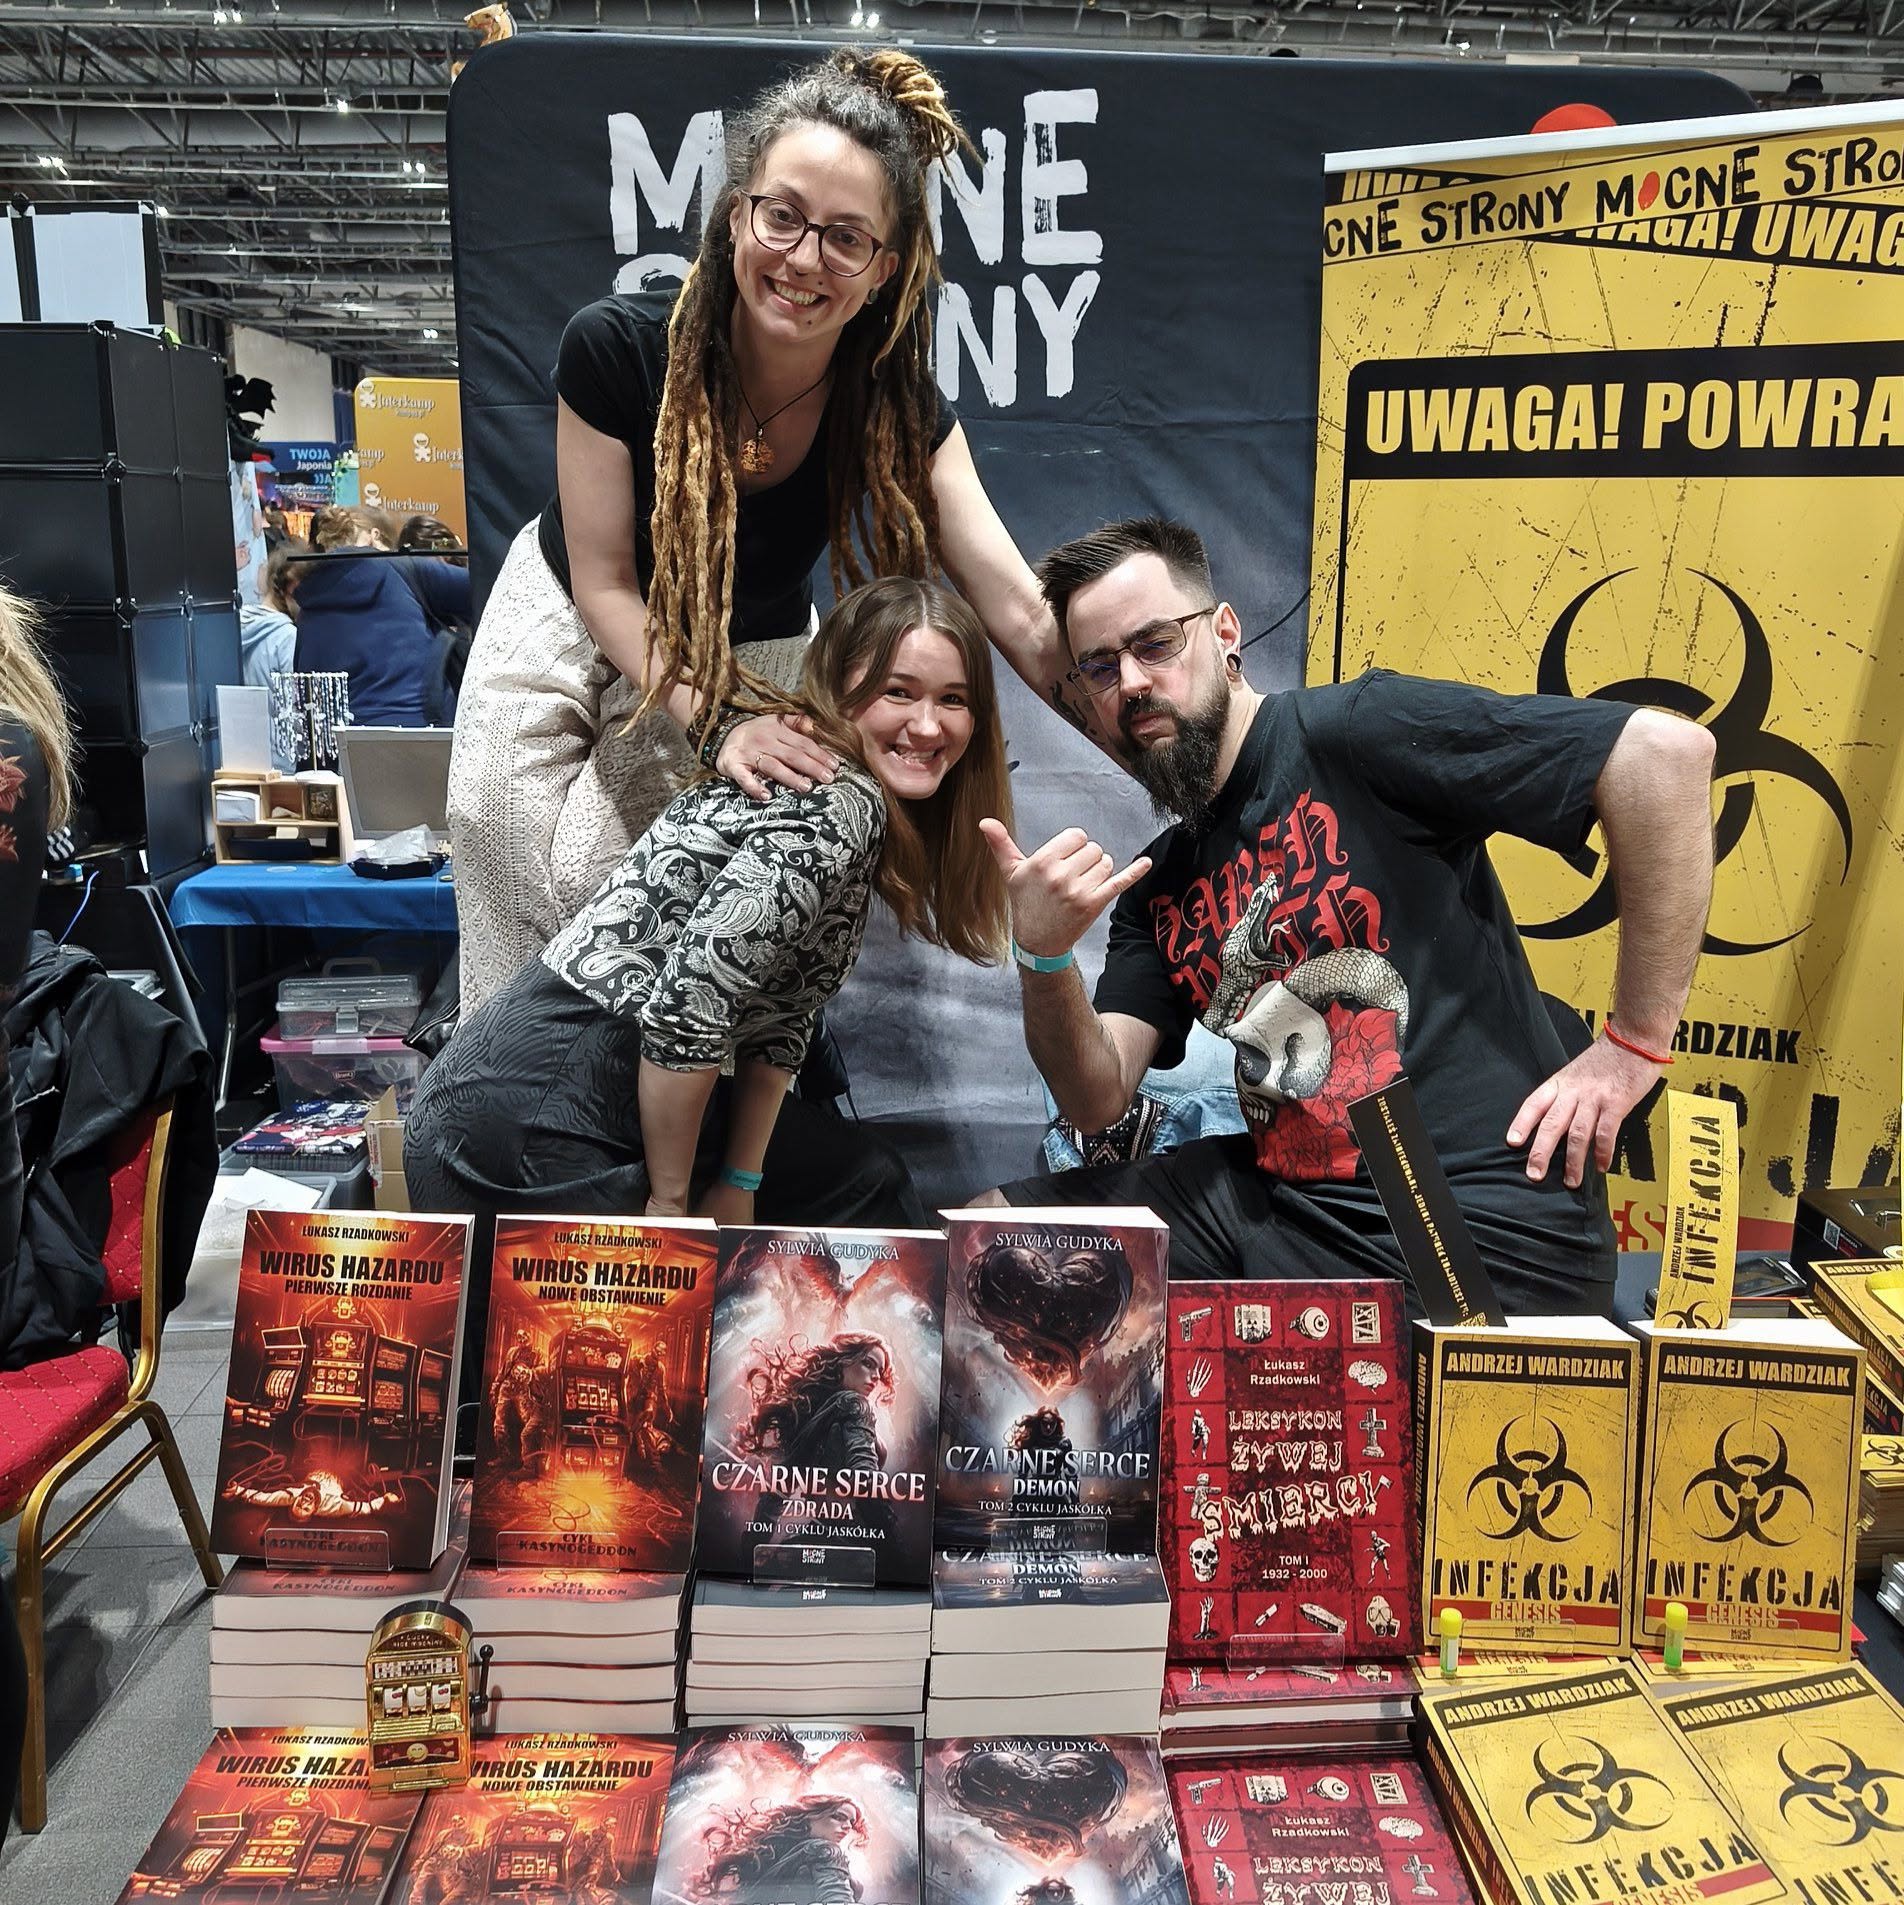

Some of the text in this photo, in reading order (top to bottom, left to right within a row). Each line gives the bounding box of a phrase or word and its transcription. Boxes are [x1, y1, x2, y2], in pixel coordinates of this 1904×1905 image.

[608, 88, 1103, 265] MNE
[1366, 376, 1904, 454] UWAGA! POWRA
[289, 448, 331, 460] TWOJA
[296, 460, 333, 472] Japonia
[1671, 1019, 1801, 1064] RDZIAK
[1682, 1115, 1722, 1285] INFEKCJA
[302, 1225, 410, 1243] ŁUKASZ RZADKOWSKI
[554, 1232, 663, 1250] ŁUKASZ RZADKOWSKI
[995, 1232, 1124, 1252] SYLWIA GUDYKA
[1669, 1205, 1686, 1279] ANDRZEJ WARDZIAK
[766, 1239, 900, 1261] SYLWIA GUDYKA
[259, 1250, 445, 1285] WIRUS HAZARDU
[512, 1257, 698, 1291] WIRUS HAZARDU
[285, 1279, 413, 1301] PIERWSZE ROZDANIE
[538, 1285, 666, 1306] NOWE OBSTAWIENIE
[1264, 1359, 1305, 1371] Łukasz
[1446, 1352, 1625, 1380] ANDRZEJ WARDZIAK
[1663, 1354, 1744, 1379] ANDRZEJ
[1749, 1359, 1851, 1388] WARDZIAK
[1250, 1374, 1321, 1386] Rzadkowski
[1416, 1352, 1427, 1420] ANDRZEJ
[1228, 1409, 1343, 1432] LEKSYKON
[945, 1445, 1151, 1480] CZARNE SERCE
[1231, 1435, 1343, 1474] ŻYWEJ
[1415, 1422, 1426, 1505] WARDZIAK
[711, 1461, 926, 1502] CZARNE SERCE
[1012, 1478, 1082, 1497] DEMON
[781, 1499, 854, 1521] ZDRADA
[978, 1499, 1113, 1516] TOM 2 CYKLU JASKÓŁKA
[562, 1533, 594, 1545] CYKL
[745, 1521, 773, 1533] TOM
[785, 1523, 826, 1536] CYKLU
[827, 1523, 886, 1540] JASKÓŁKA
[519, 1540, 638, 1557] KASYNOGEDDON
[1012, 1563, 1082, 1575] DEMON
[1278, 1555, 1305, 1566] TOM
[978, 1577, 1007, 1585] TOM
[1008, 1577, 1015, 1585] 2
[1018, 1576, 1059, 1585] CYKLU
[1262, 1569, 1291, 1579] 1932
[1299, 1569, 1328, 1579] 2000
[1433, 1558, 1620, 1604] INFEKCJA
[1647, 1558, 1840, 1611] INFEKCJA
[506, 1586, 628, 1596] KASYNOGEDDON
[1490, 1601, 1562, 1624] GENESIS
[1706, 1602, 1780, 1629] GENESIS
[1443, 1676, 1633, 1725] ANDRZEJ WARDZIAK
[1675, 1676, 1867, 1727] ANDRZEJ WARDZIAK
[271, 1735, 369, 1746] ŁUKASZ RZADKOW
[547, 1740, 618, 1750] RZADKOWSKI
[727, 1731, 867, 1743] SYLWIA GUDYKA
[973, 1741, 1111, 1754] SYLWIA GUDYKA
[216, 1756, 369, 1777] WIRUS HAZA
[543, 1760, 654, 1779] HAZARDU
[236, 1776, 308, 1788] PIERWSZE
[481, 1780, 619, 1792] NOWE OBSTAWIENIE
[1285, 1815, 1331, 1826] Łukasz
[1271, 1826, 1350, 1837] Rzadkowski
[1252, 1855, 1384, 1875] LEKSYKON
[1524, 1832, 1759, 1905] INFEKCJA
[1262, 1877, 1391, 1905] ŻYWEJ
